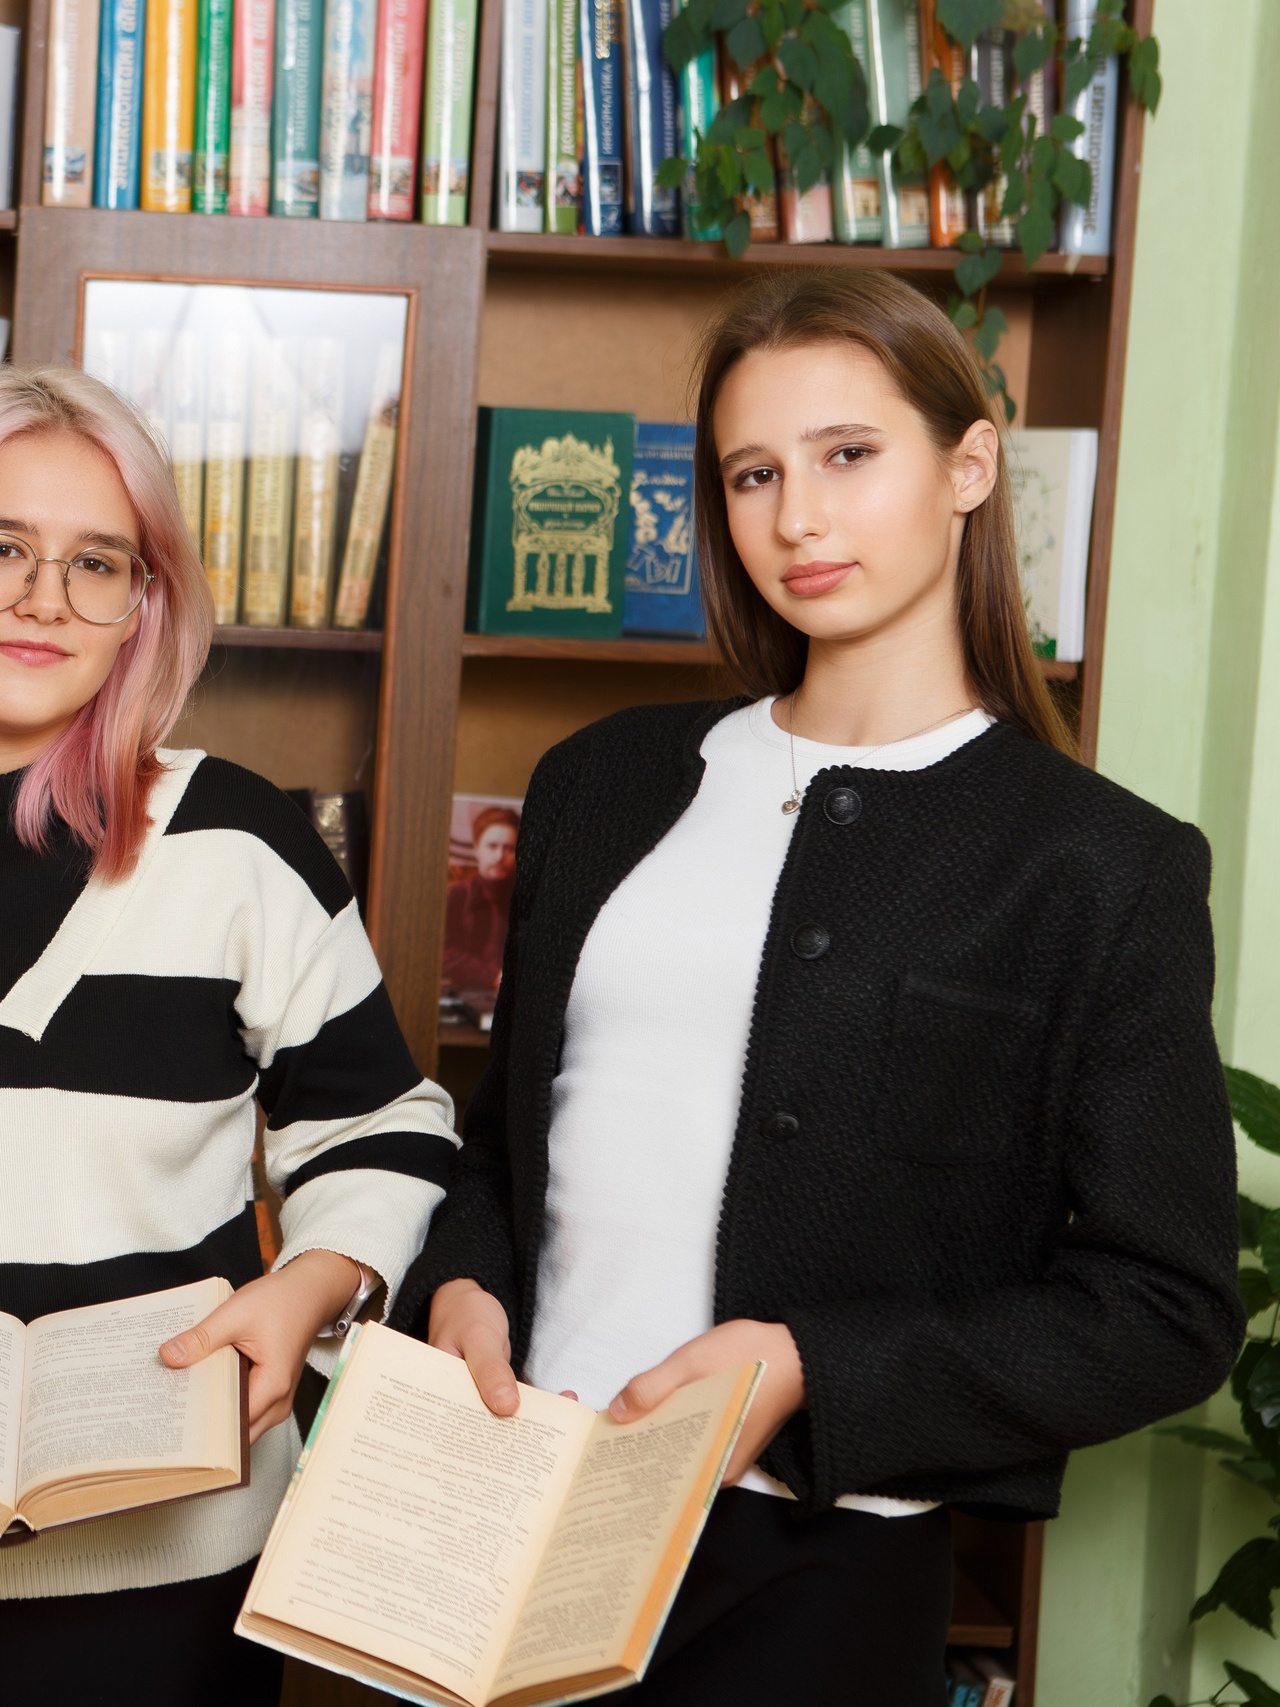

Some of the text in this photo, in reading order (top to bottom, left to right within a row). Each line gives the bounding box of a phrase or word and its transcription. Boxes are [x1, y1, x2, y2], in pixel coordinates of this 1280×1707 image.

[452, 20, 468, 103] ЧЕЛОВЕКА
[560, 65, 576, 156] ДОМАШНИЕ
[599, 62, 614, 156] ИНФОРМАТИКА
